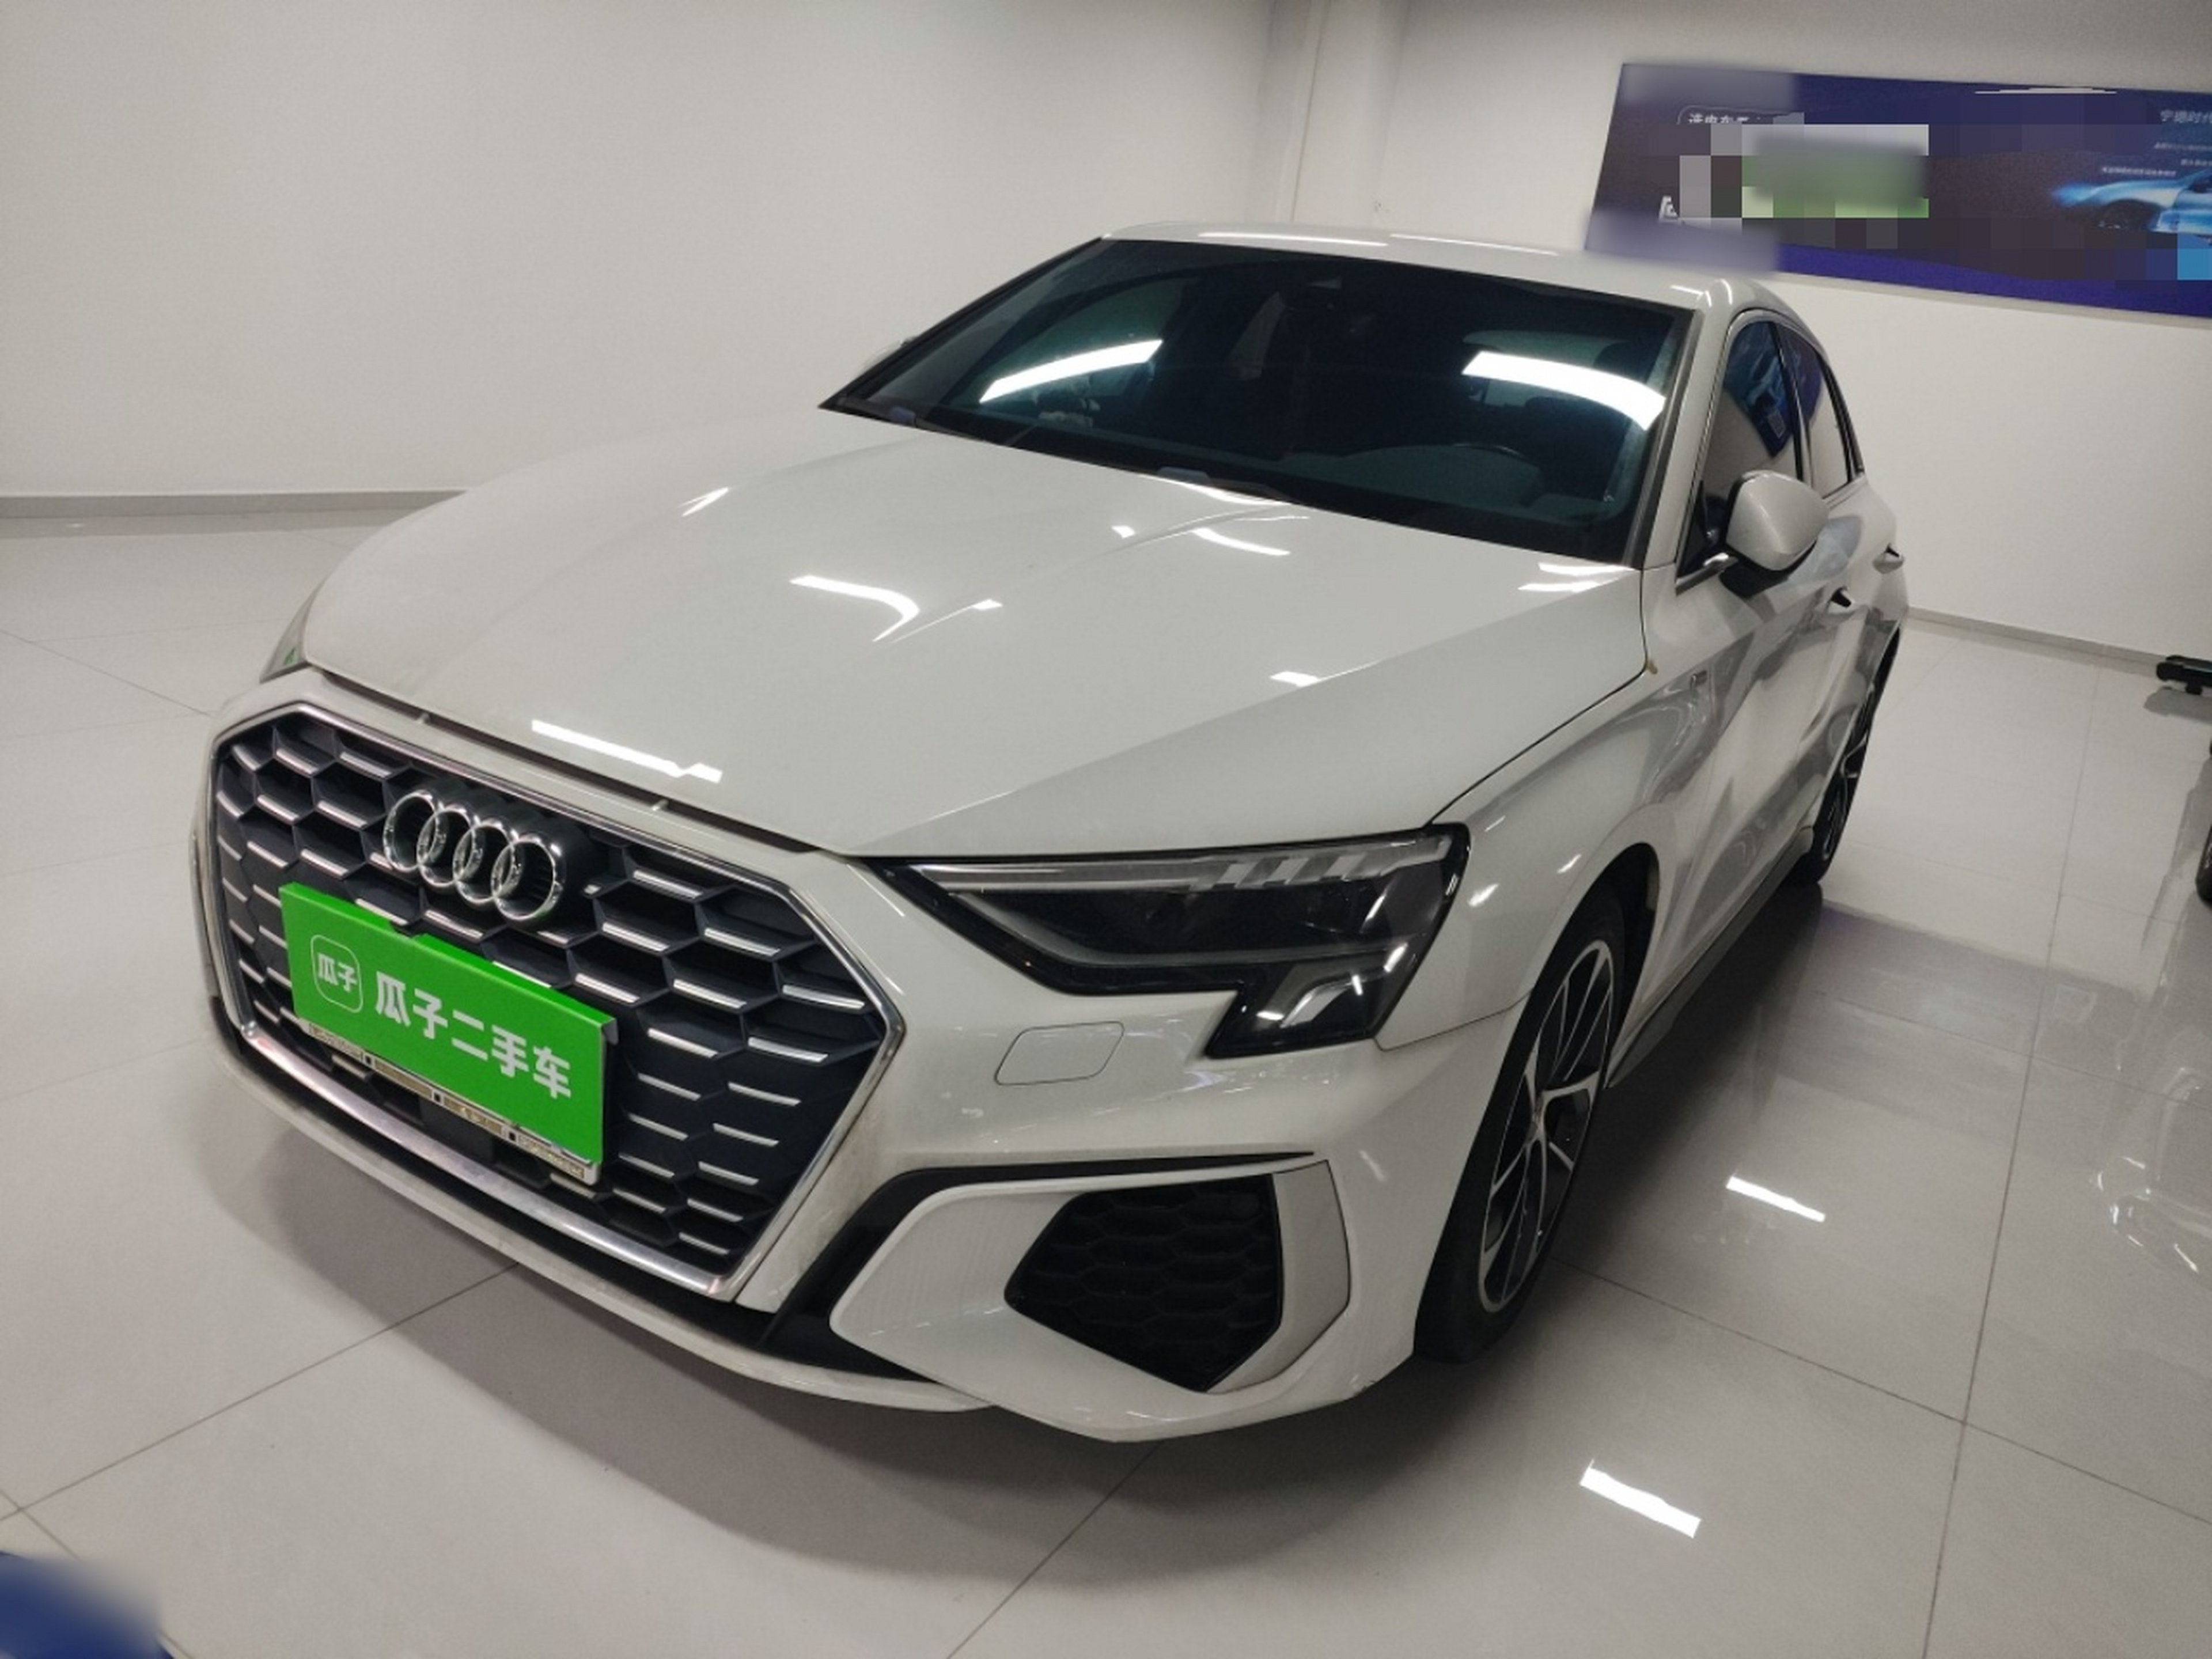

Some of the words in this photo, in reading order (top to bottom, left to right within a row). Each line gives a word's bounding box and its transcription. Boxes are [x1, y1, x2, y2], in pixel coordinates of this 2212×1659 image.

[317, 953, 357, 993] 瓜子
[376, 971, 571, 1099] 瓜子二手车
